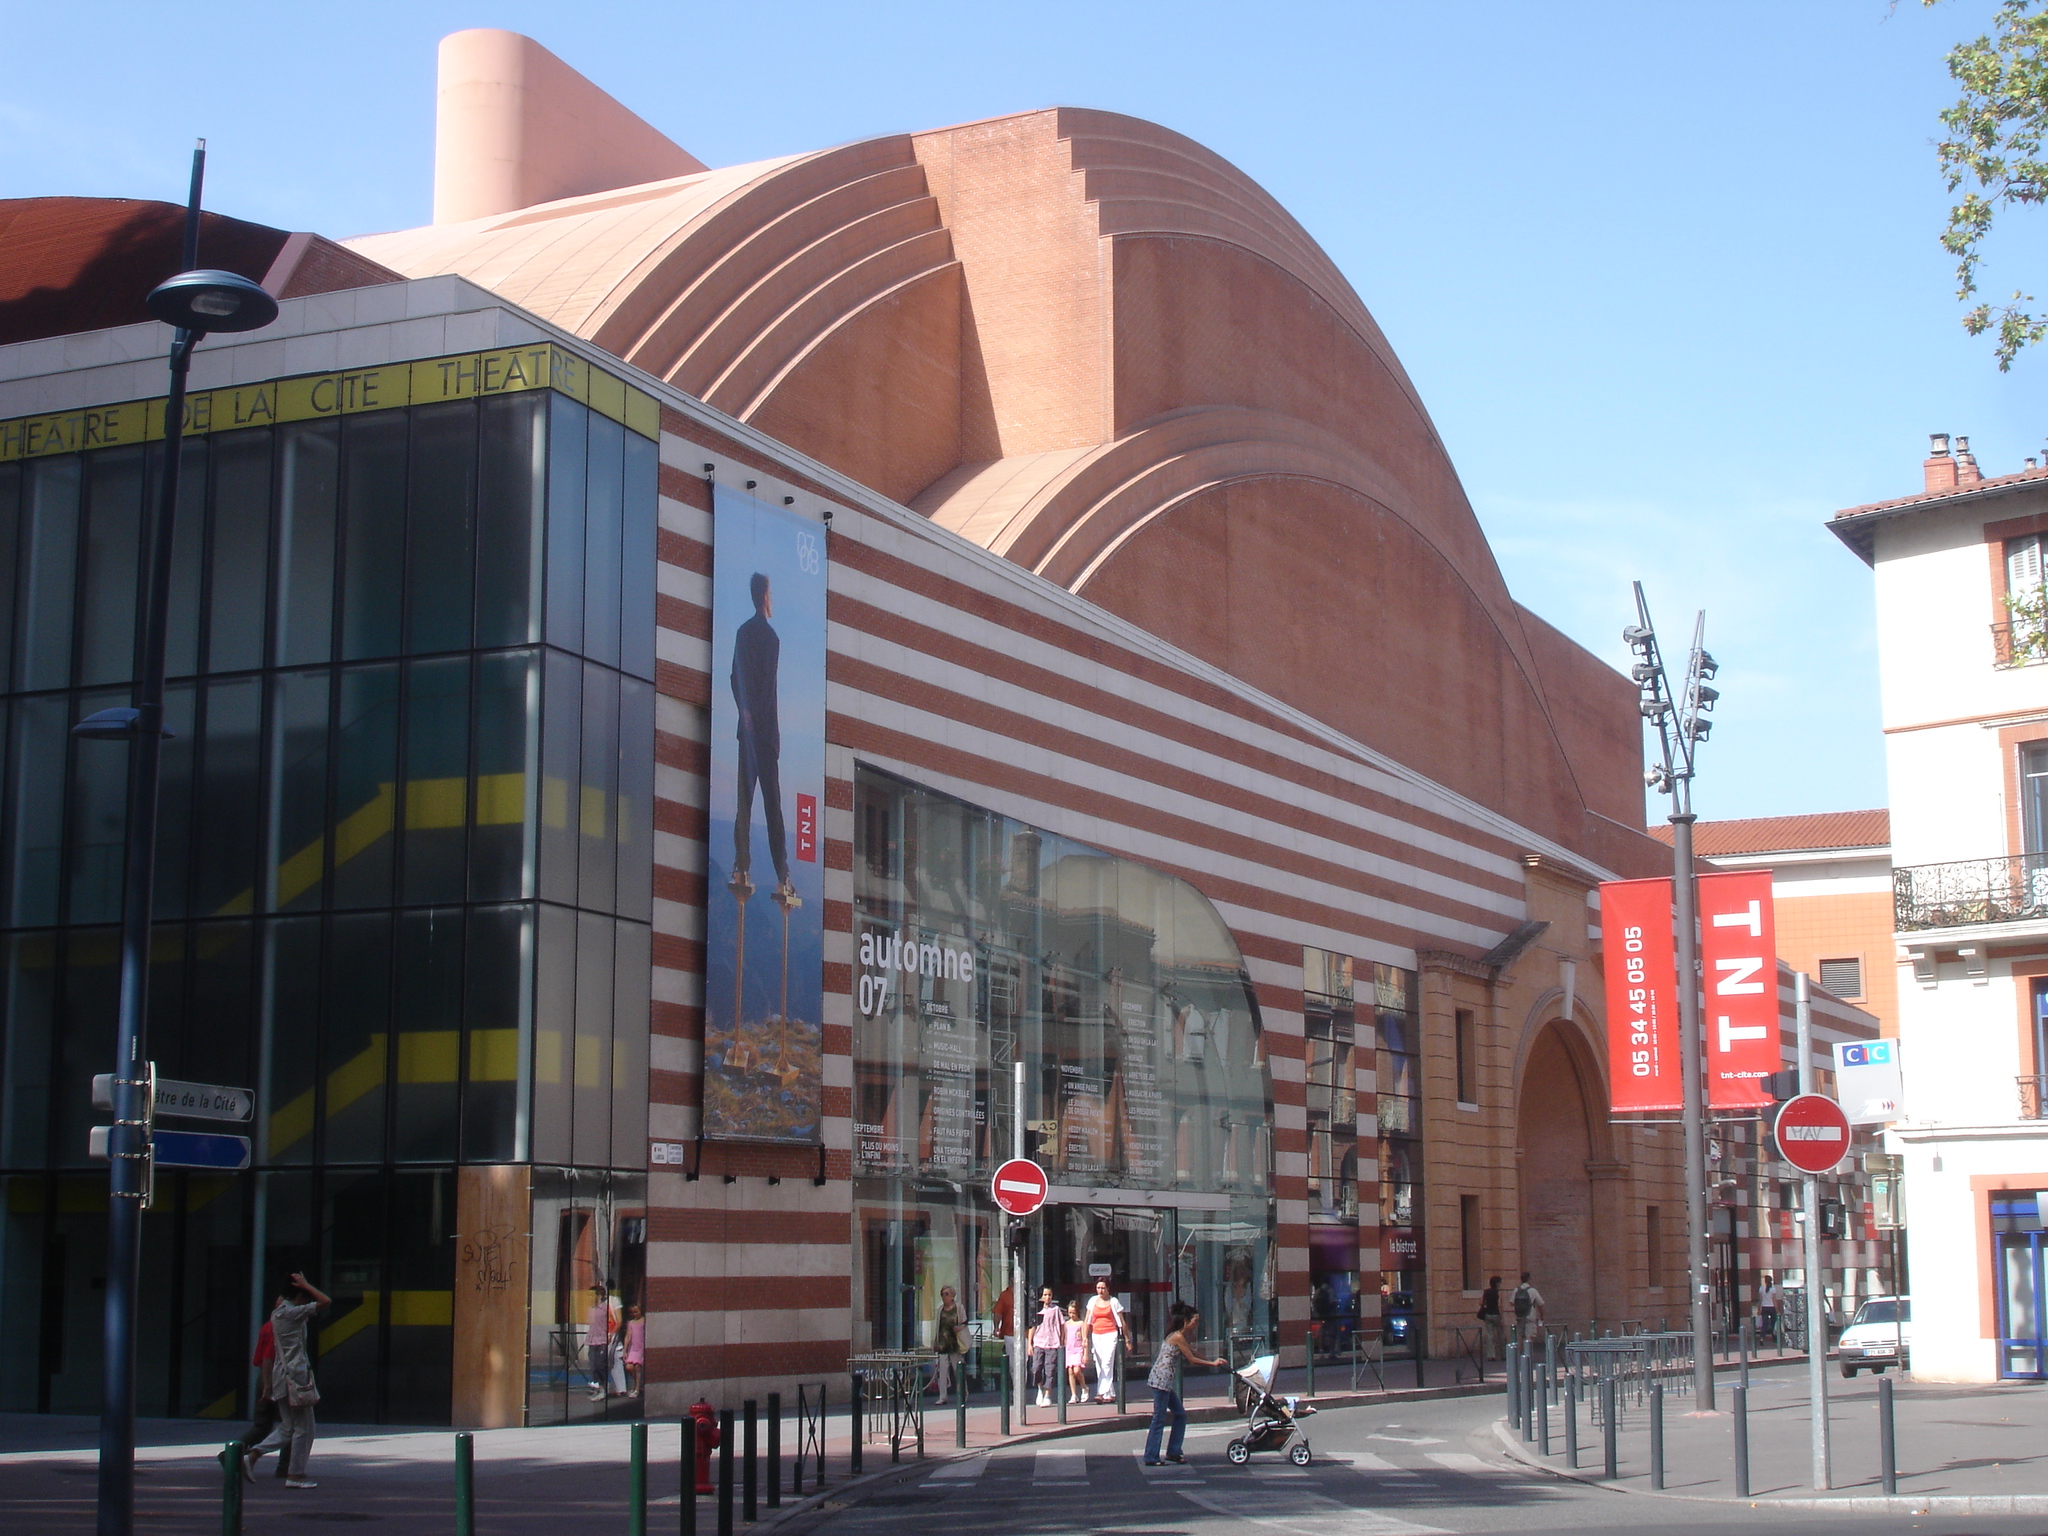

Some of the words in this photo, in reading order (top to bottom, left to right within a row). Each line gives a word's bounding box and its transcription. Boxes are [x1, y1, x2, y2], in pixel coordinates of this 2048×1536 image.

[234, 388, 272, 424] LA
[801, 806, 811, 850] TNT
[1624, 926, 1643, 952] 05
[860, 930, 973, 983] automne
[1626, 957, 1645, 983] 05
[1713, 900, 1767, 1053] TNT
[860, 974, 888, 1017] 07
[1629, 988, 1647, 1015] 45
[1630, 1018, 1649, 1045] 34
[1632, 1050, 1650, 1077] 05
[1846, 1045, 1886, 1063] CIC
[1720, 1071, 1769, 1079] tnt-cite.com
[155, 1089, 177, 1105] âtre
[182, 1092, 195, 1107] de
[199, 1094, 209, 1109] la
[214, 1095, 236, 1112] Cité
[853, 1123, 884, 1134] SEPTEMBRE
[861, 1141, 875, 1150] PLUS
[1389, 1238, 1396, 1253] le
[1396, 1238, 1417, 1253] bistrot
